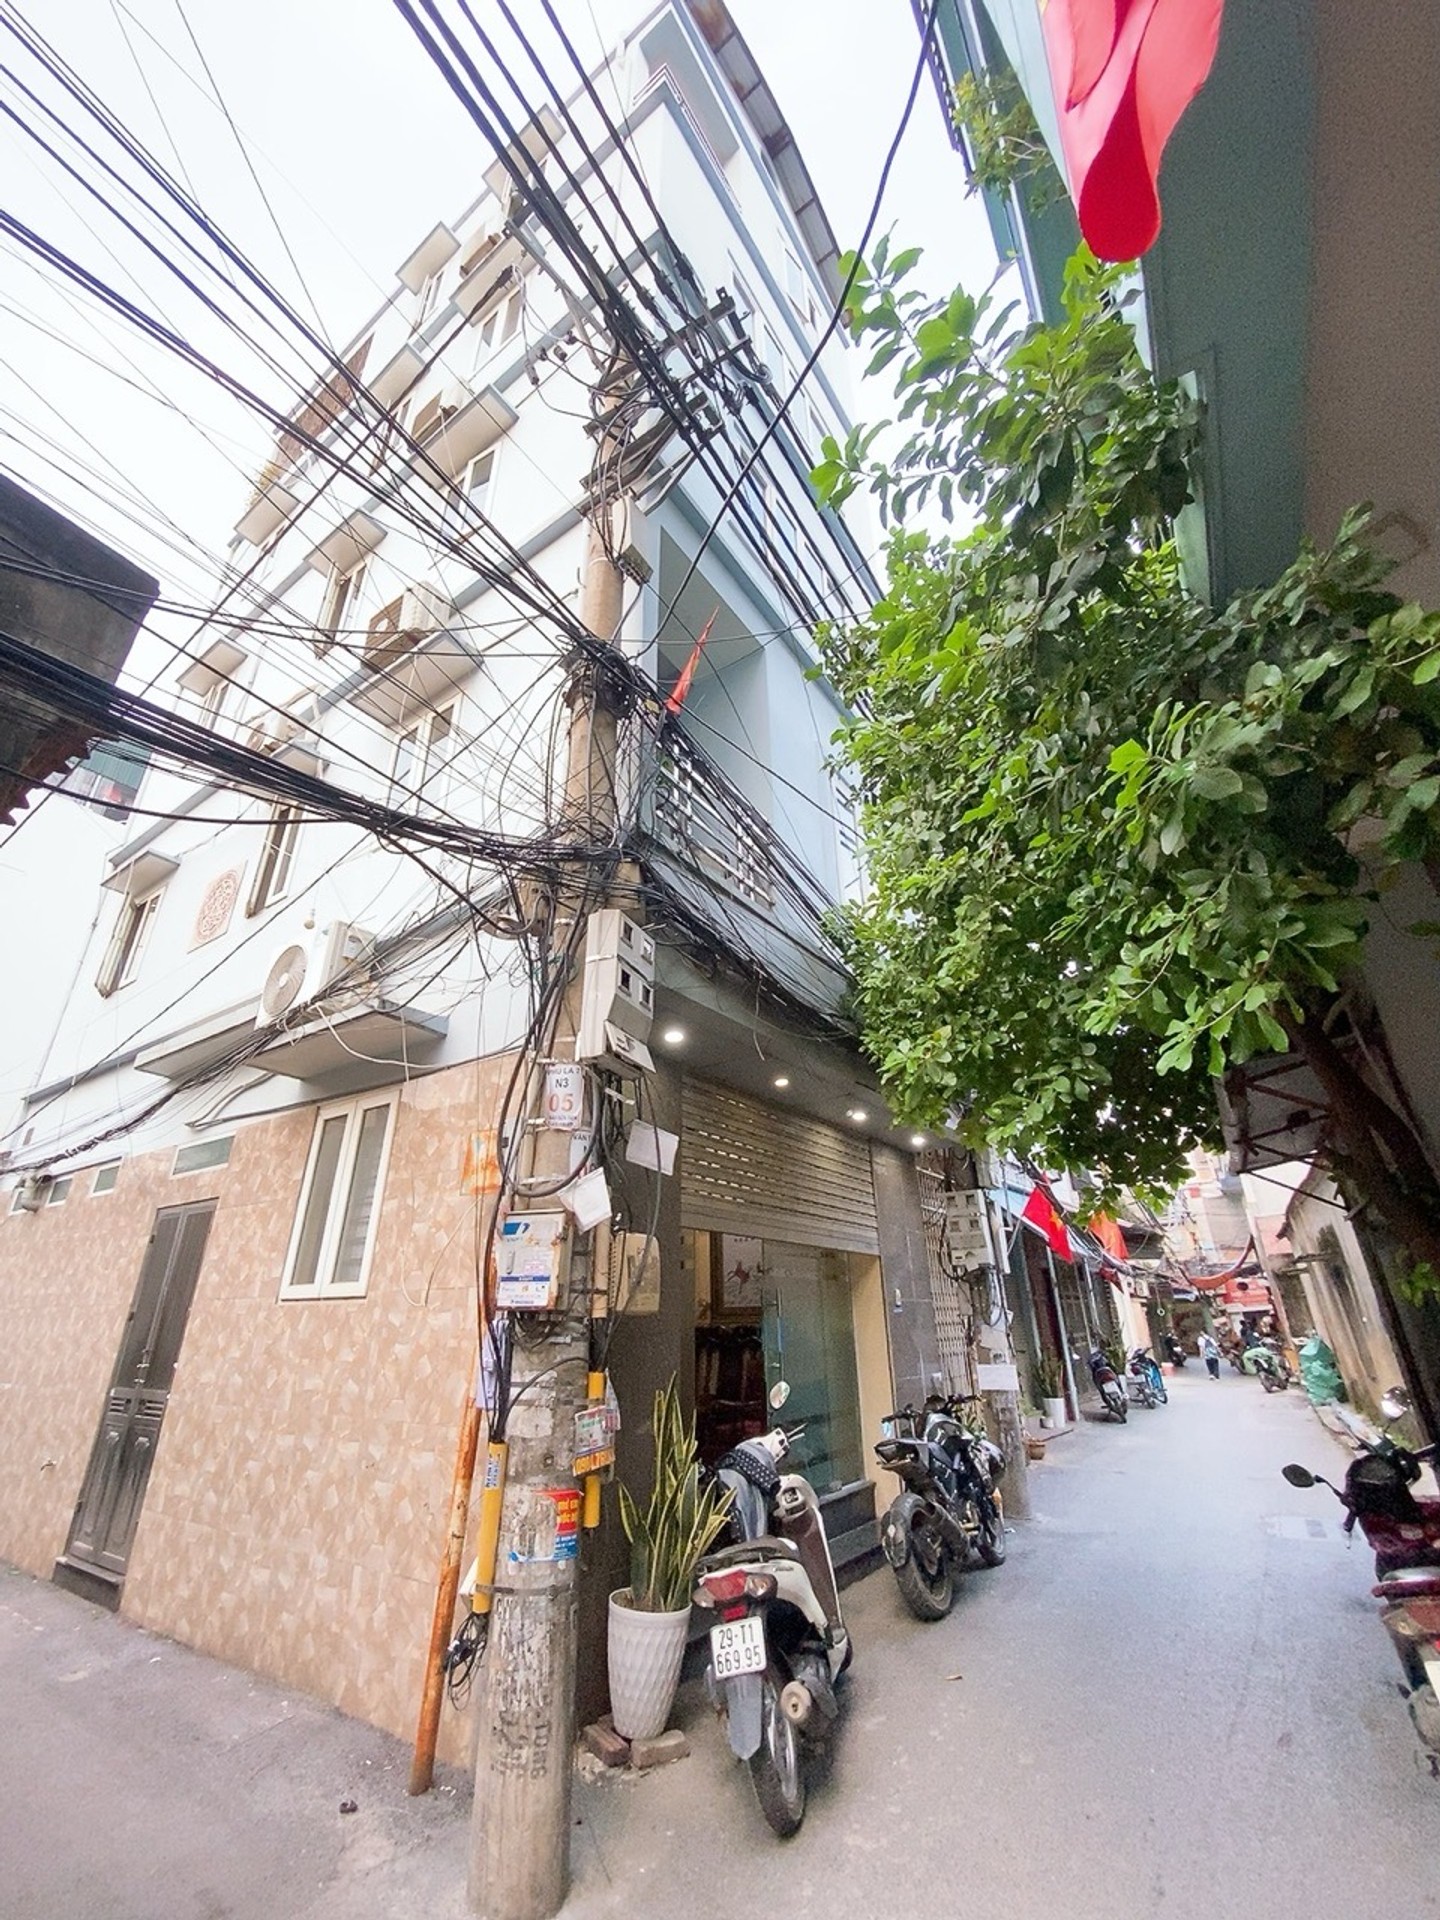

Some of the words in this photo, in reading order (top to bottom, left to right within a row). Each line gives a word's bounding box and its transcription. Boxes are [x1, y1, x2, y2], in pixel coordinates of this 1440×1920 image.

[555, 1077, 570, 1088] N3
[549, 1093, 573, 1112] 05
[718, 1623, 754, 1650] 29-T1
[716, 1645, 761, 1674] 669.95
